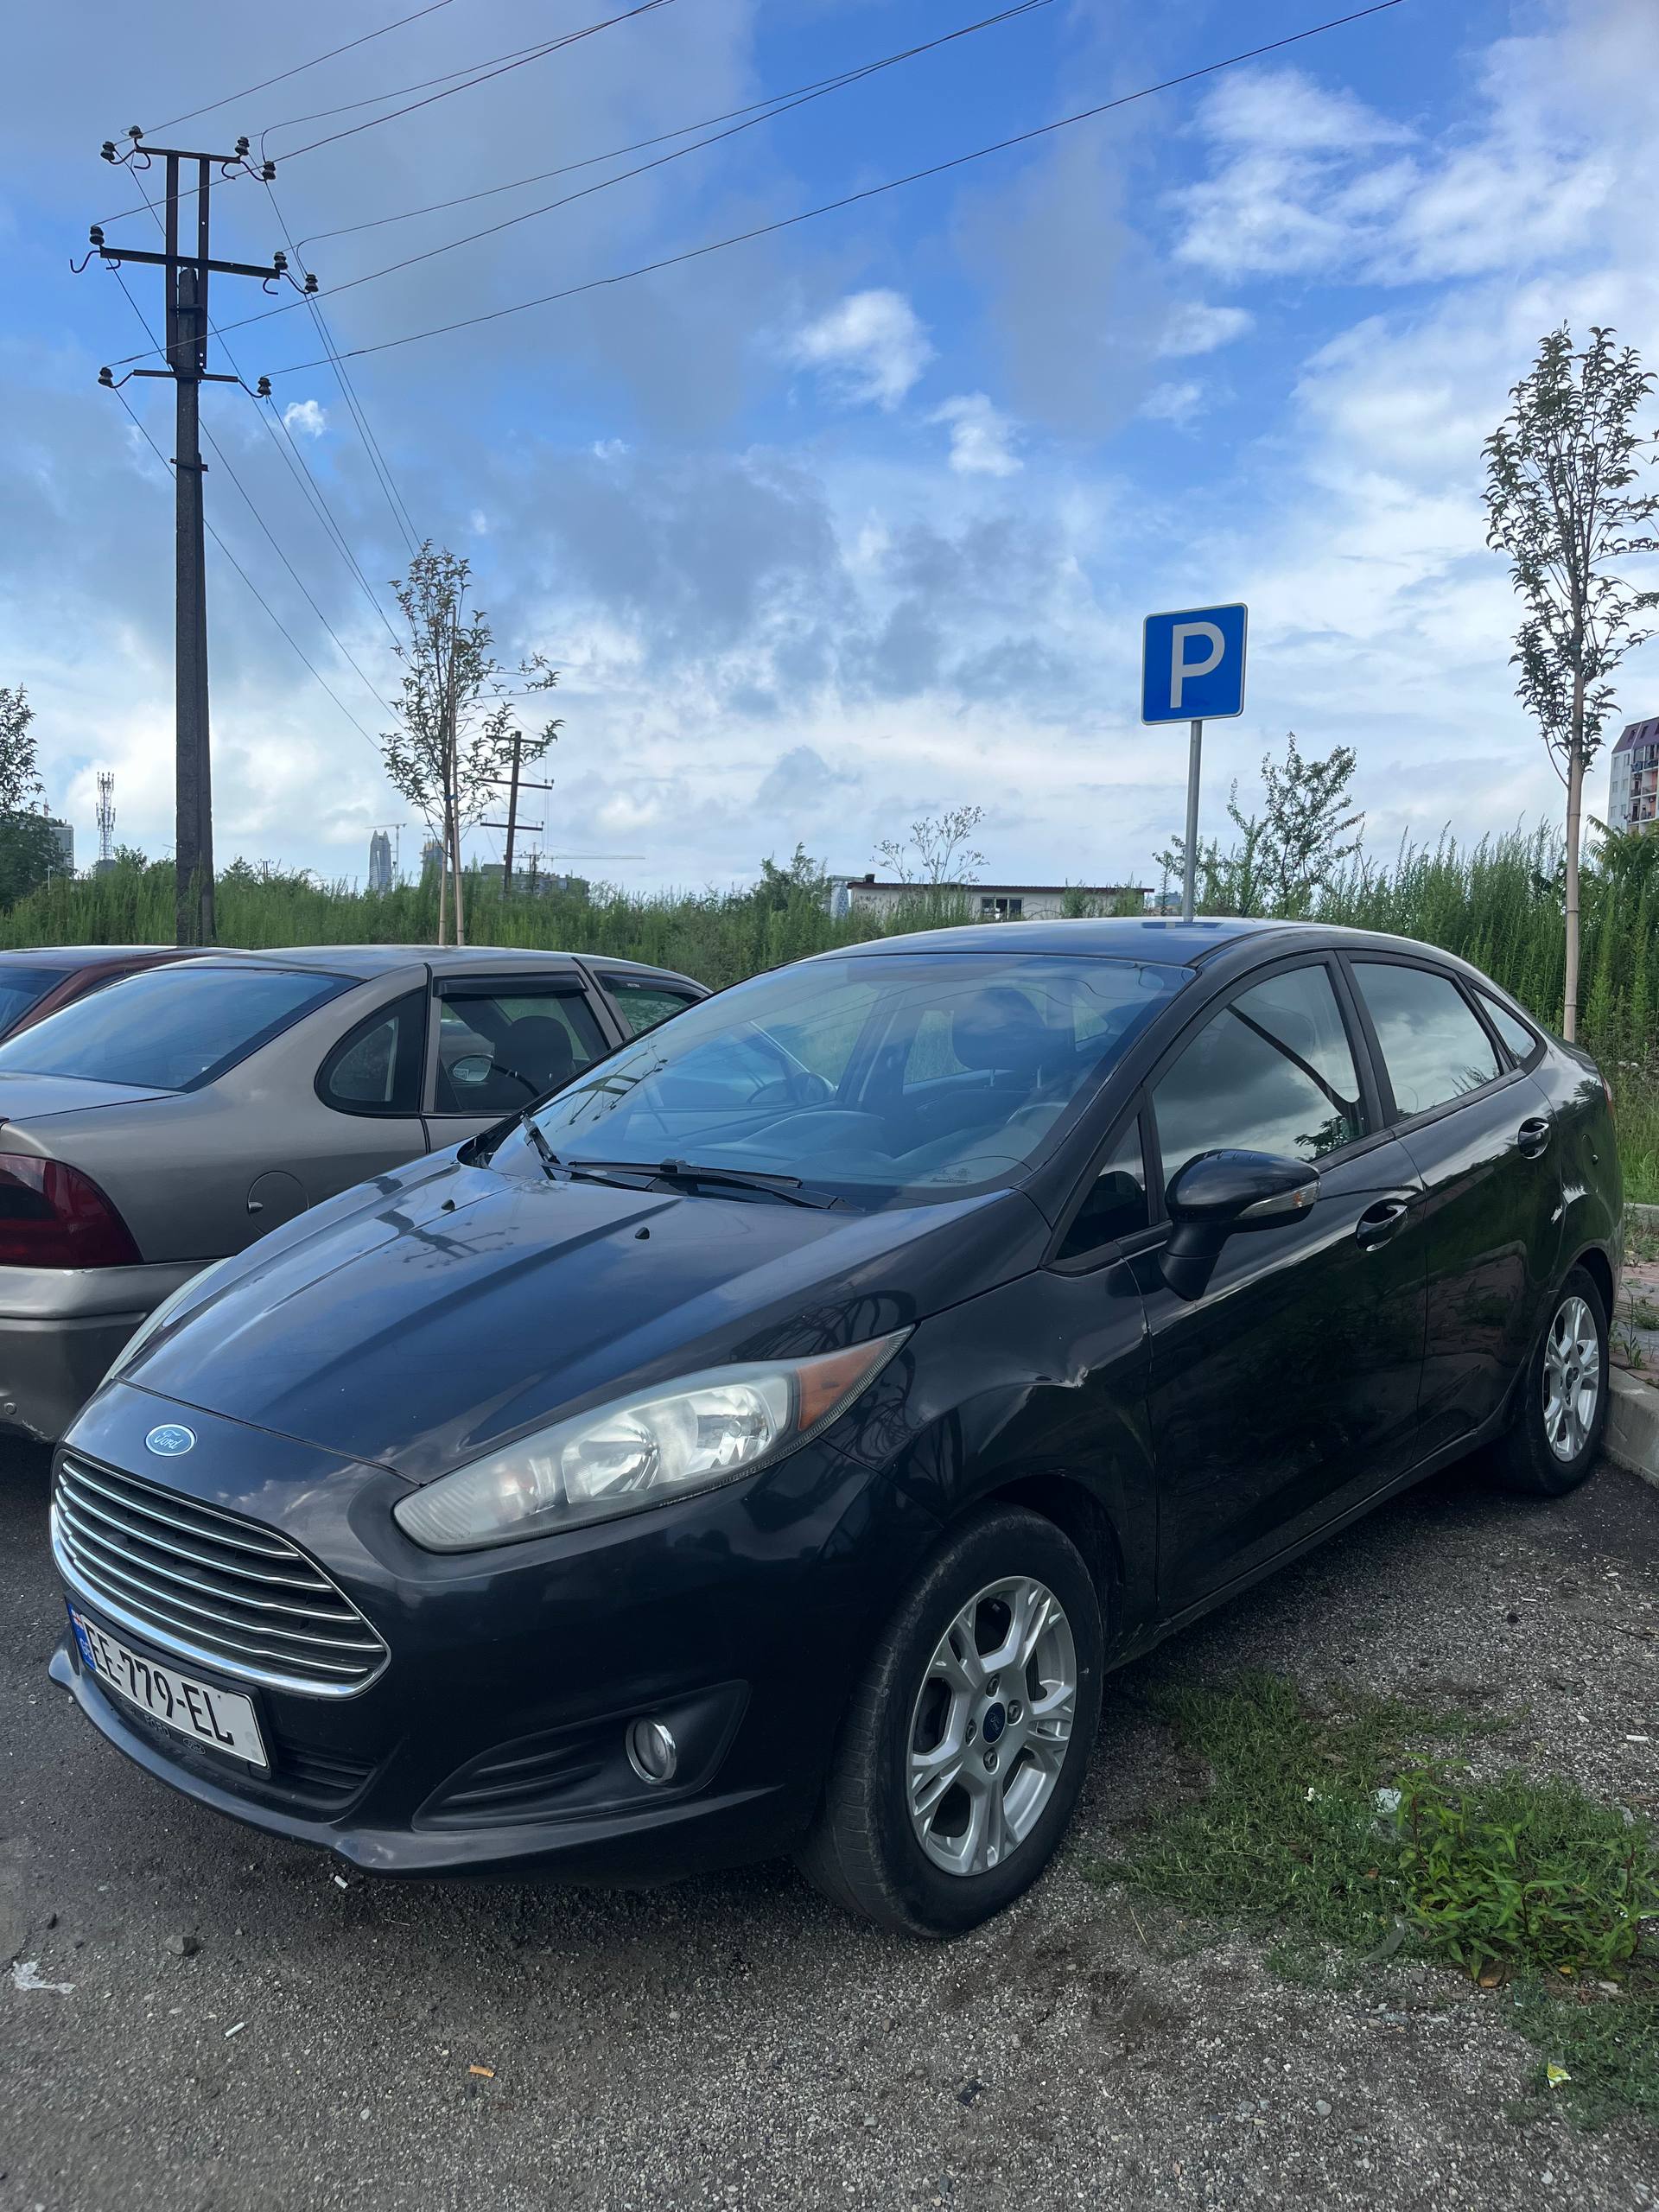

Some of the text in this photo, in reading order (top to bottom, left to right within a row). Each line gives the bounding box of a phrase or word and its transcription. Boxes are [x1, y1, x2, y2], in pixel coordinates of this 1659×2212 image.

[1170, 621, 1225, 709] P
[154, 1429, 183, 1449] Ford
[84, 1622, 235, 1745] EE-779-EL
